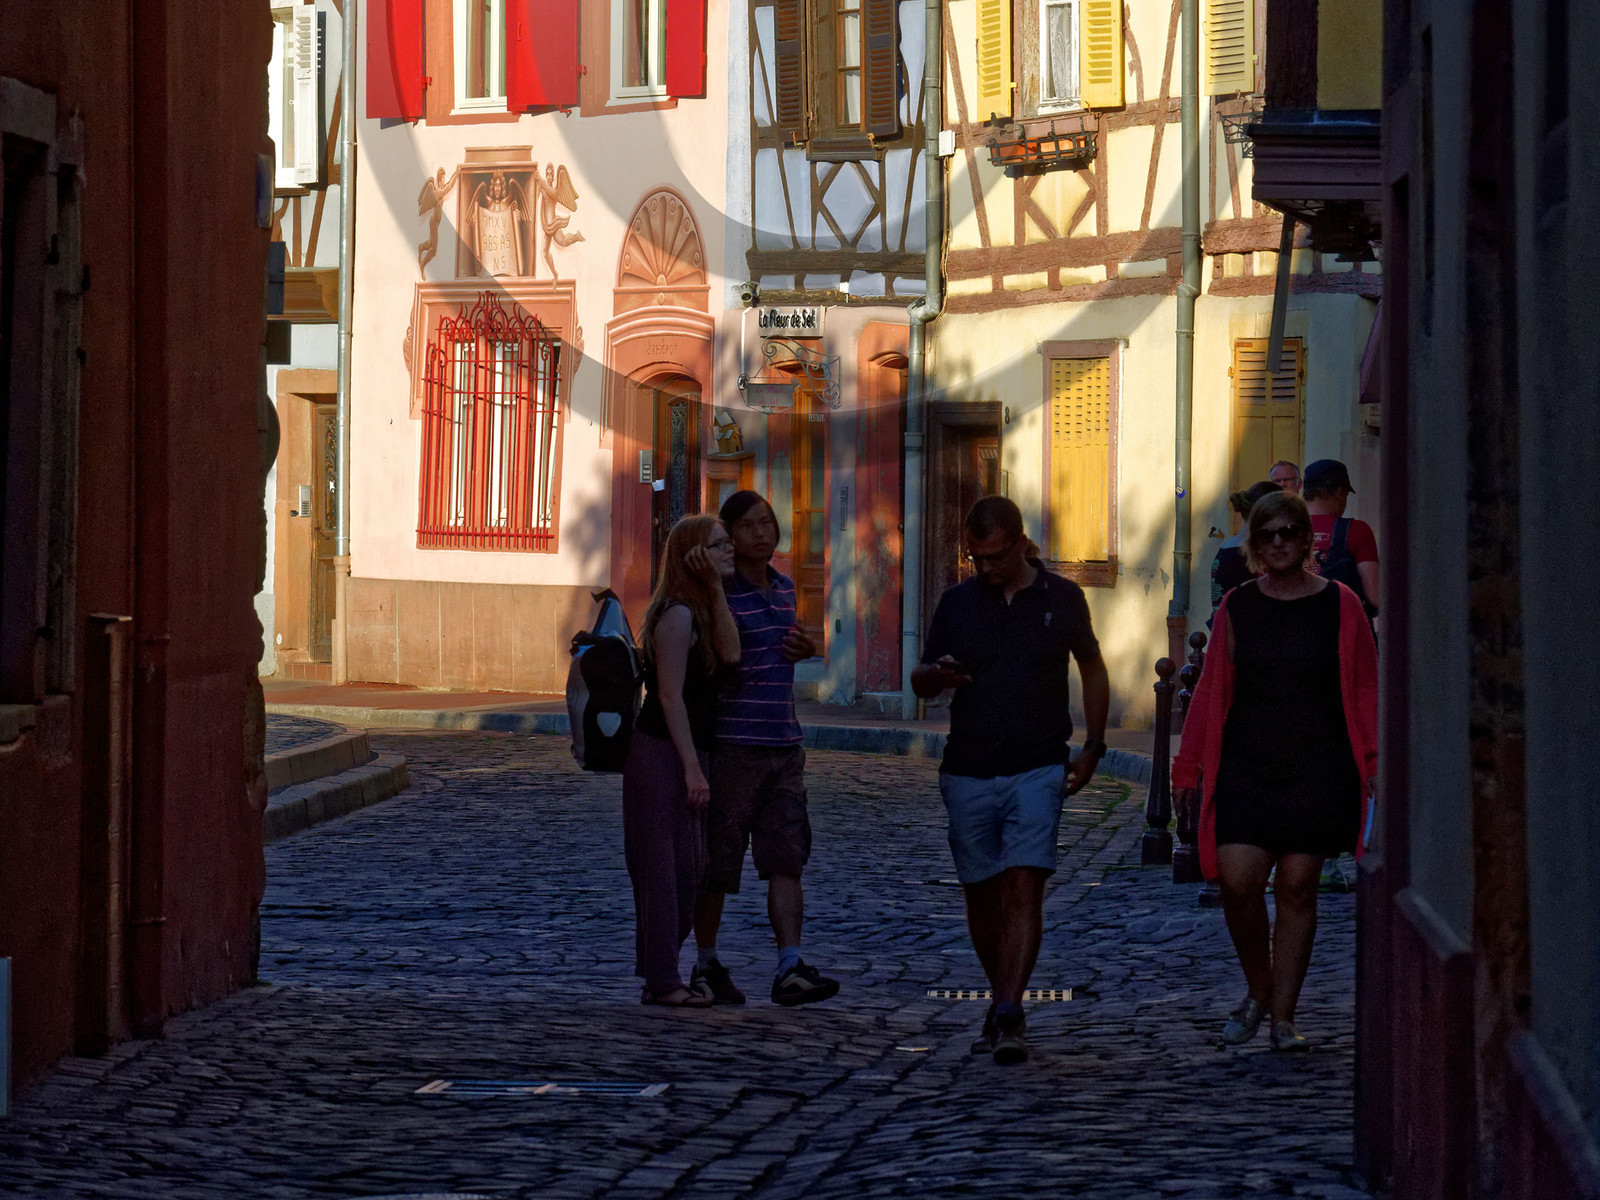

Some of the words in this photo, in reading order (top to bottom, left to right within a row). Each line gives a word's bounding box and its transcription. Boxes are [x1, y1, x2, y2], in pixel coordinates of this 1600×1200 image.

[759, 309, 768, 328] La
[769, 309, 790, 328] Fleur
[791, 309, 801, 328] de
[802, 309, 816, 328] Sel
[1005, 405, 1010, 425] 8
